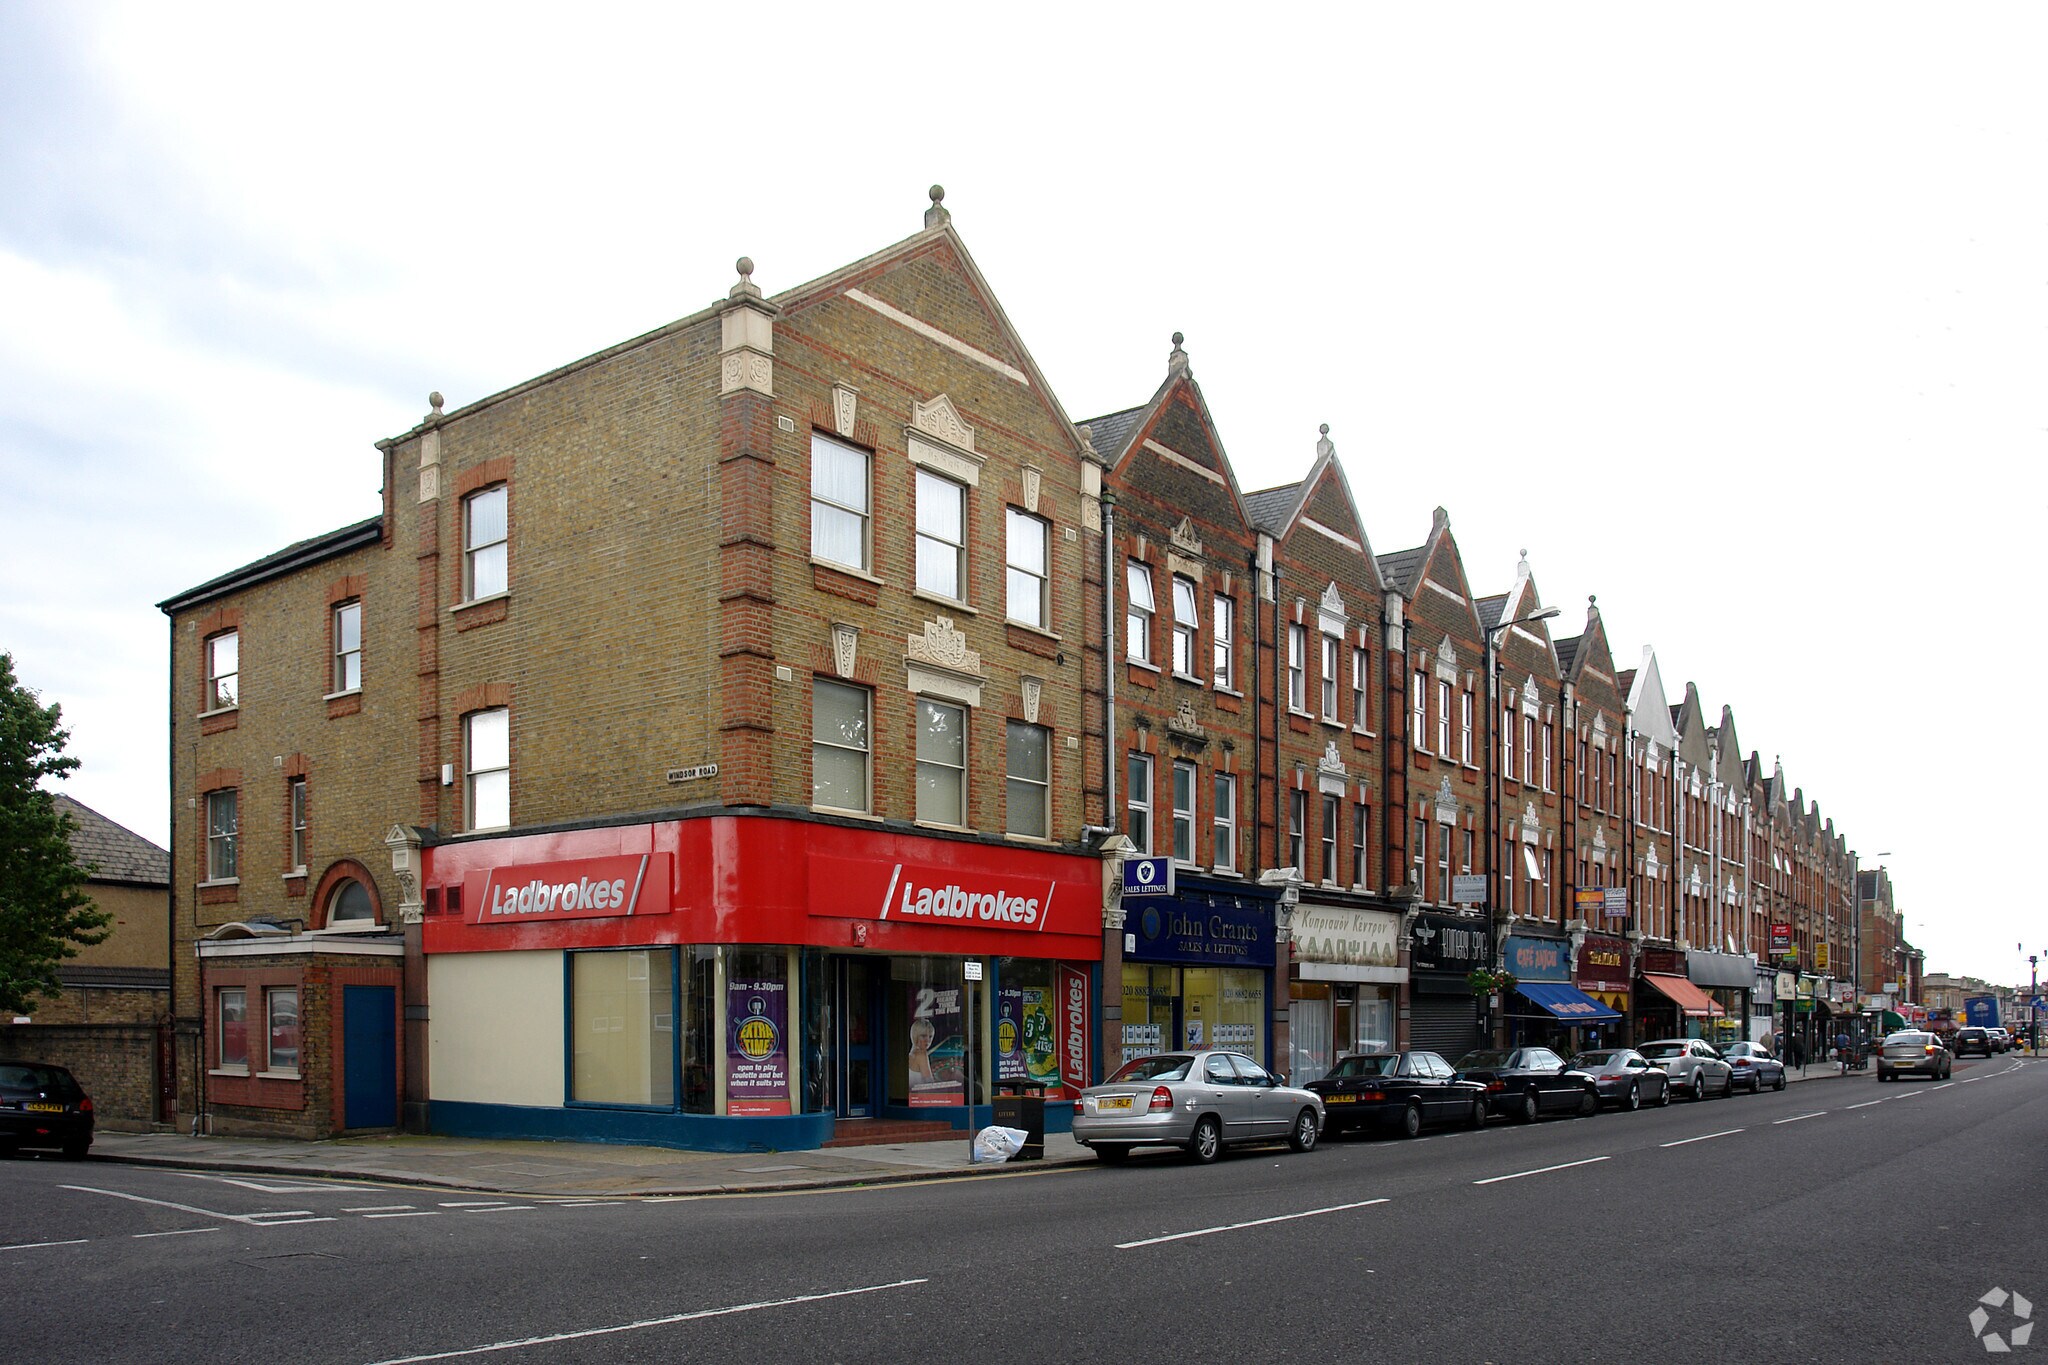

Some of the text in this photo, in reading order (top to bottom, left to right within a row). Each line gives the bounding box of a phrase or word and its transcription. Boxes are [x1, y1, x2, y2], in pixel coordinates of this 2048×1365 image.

[668, 766, 716, 780] WINDSOR ROAD
[491, 876, 626, 915] Ladbrokes
[1125, 884, 1166, 894] SALES LETTINGS
[901, 882, 1039, 924] Ladbrokes
[1166, 911, 1258, 941] John Grants
[1178, 941, 1248, 955] SALES & LETTINGS
[729, 982, 748, 990] 9am
[753, 982, 784, 992] 9.30pm
[914, 988, 935, 1018] 2
[740, 1020, 774, 1038] EXTRA
[1068, 978, 1083, 1081] Ladbrokes
[743, 1039, 770, 1055] TIME
[1117, 1098, 1132, 1108] RLF
